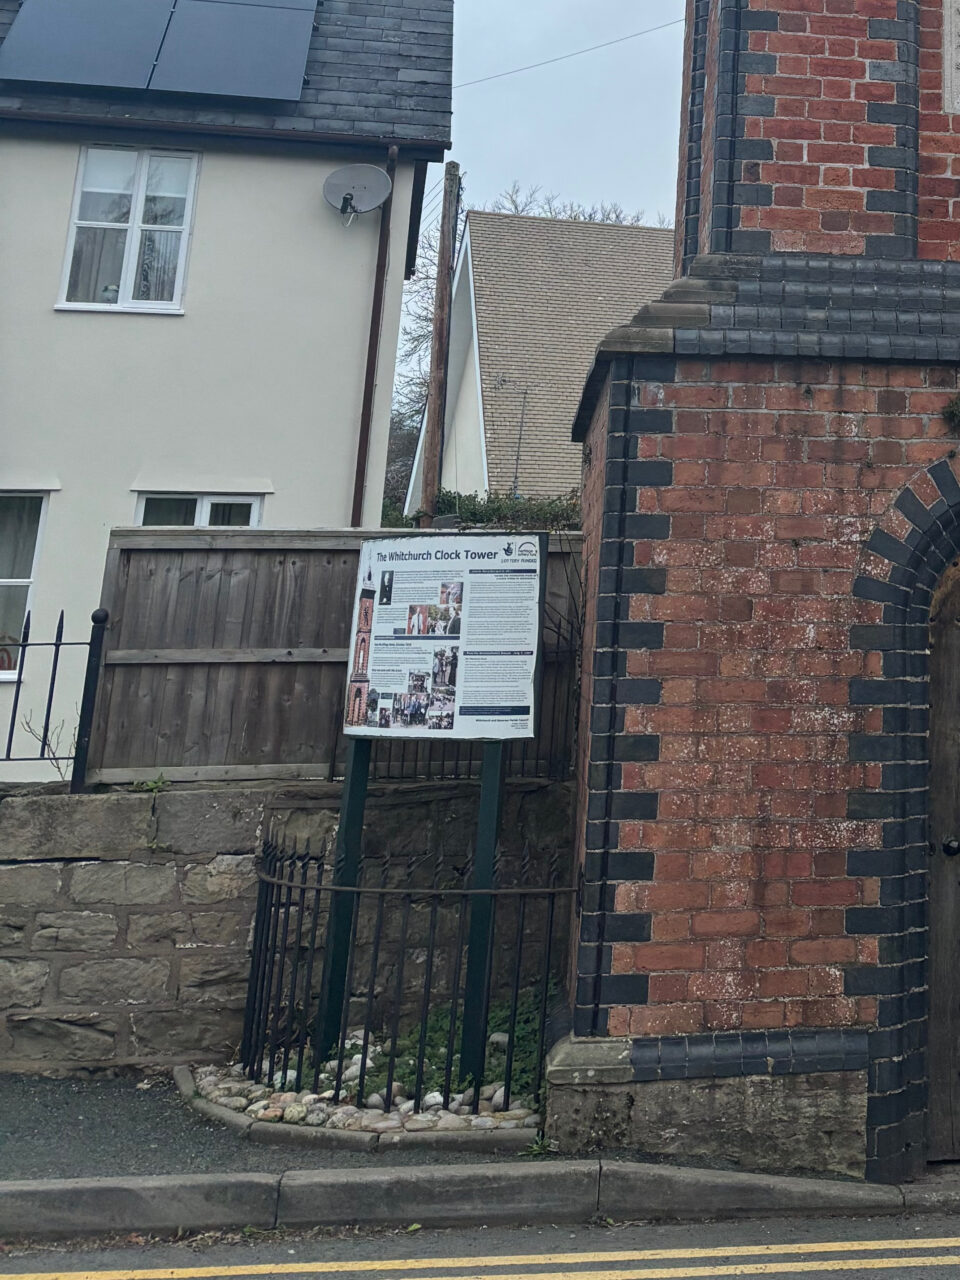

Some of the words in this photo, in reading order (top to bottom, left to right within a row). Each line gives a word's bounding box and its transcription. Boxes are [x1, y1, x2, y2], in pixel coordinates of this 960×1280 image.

[376, 552, 387, 562] The
[388, 550, 432, 562] Whitchurch
[434, 549, 460, 560] Clock
[464, 549, 499, 560] Tower
